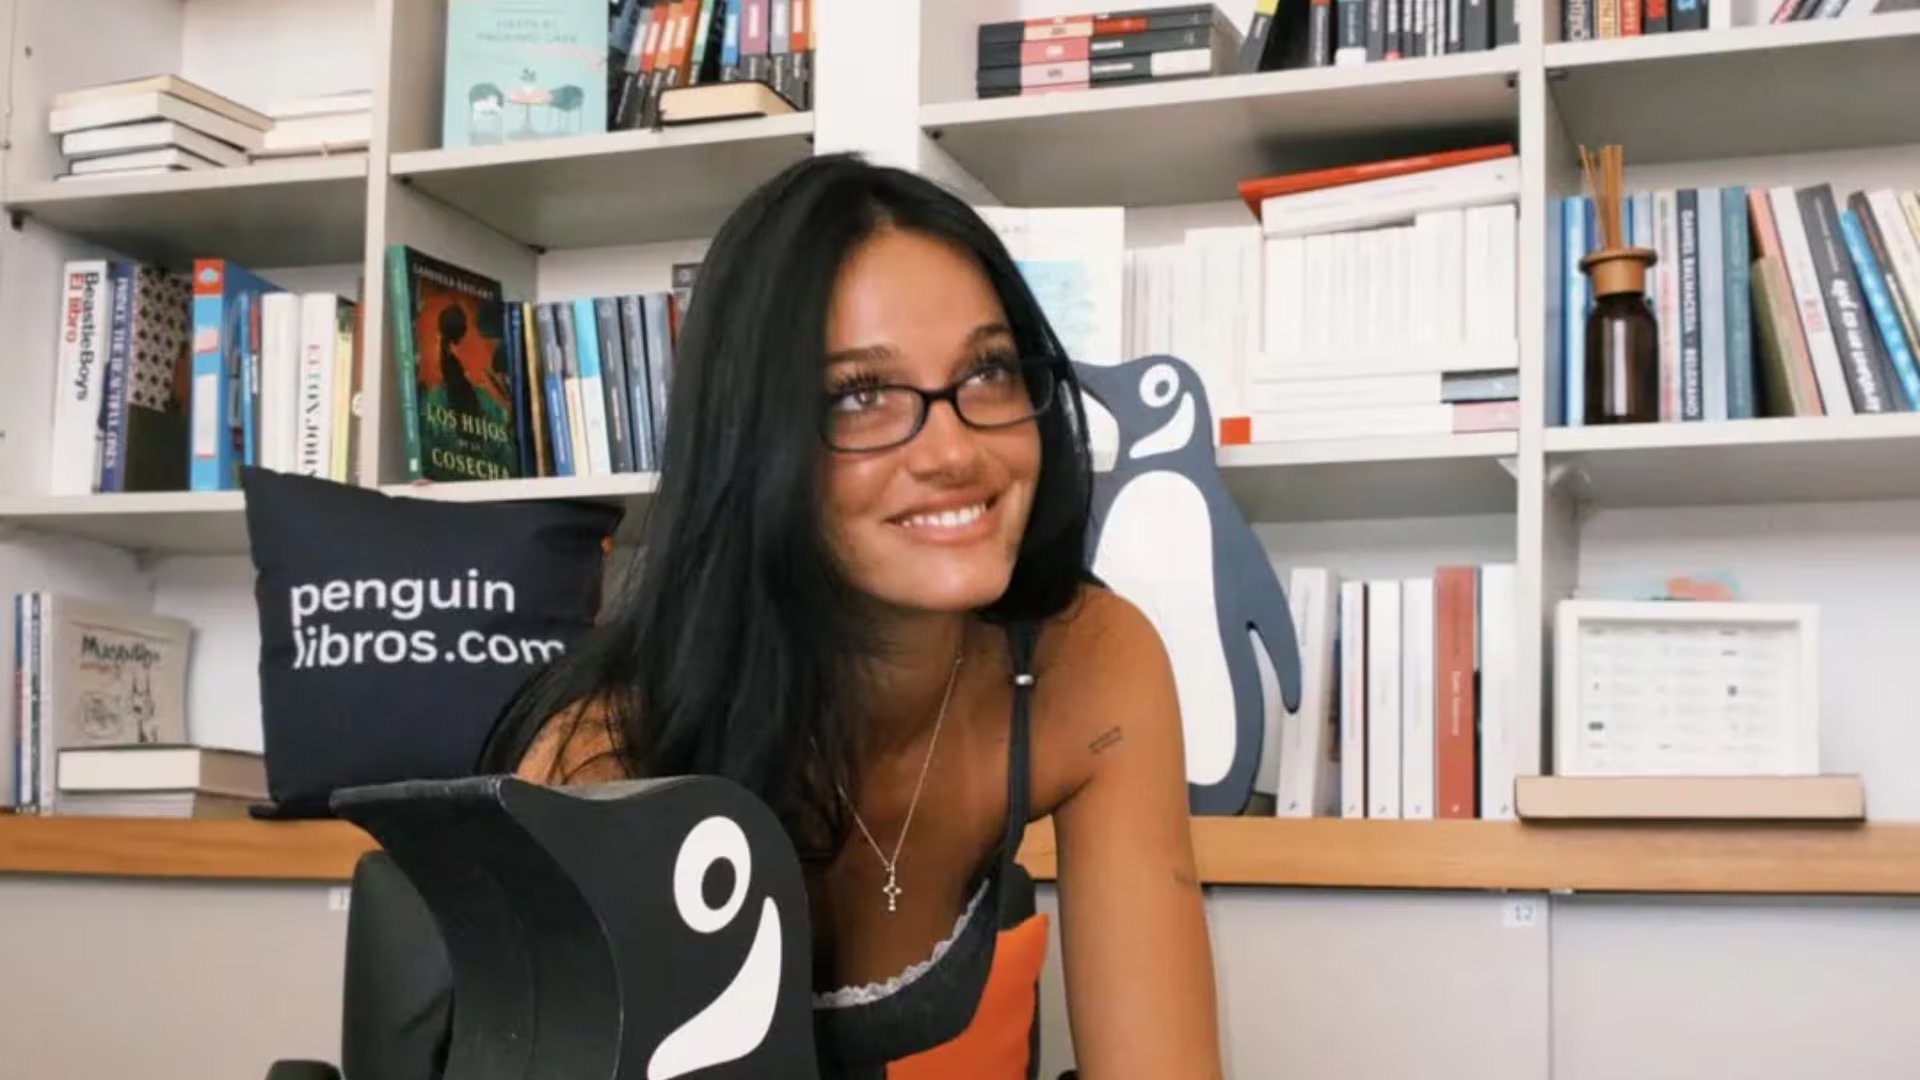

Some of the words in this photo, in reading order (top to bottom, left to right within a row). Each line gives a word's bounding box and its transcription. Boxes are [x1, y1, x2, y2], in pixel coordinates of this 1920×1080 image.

[69, 272, 85, 291] El
[426, 404, 457, 428] LOS
[462, 413, 508, 443] HIJOS
[432, 449, 510, 481] COSECHA
[290, 568, 515, 627] penguin
